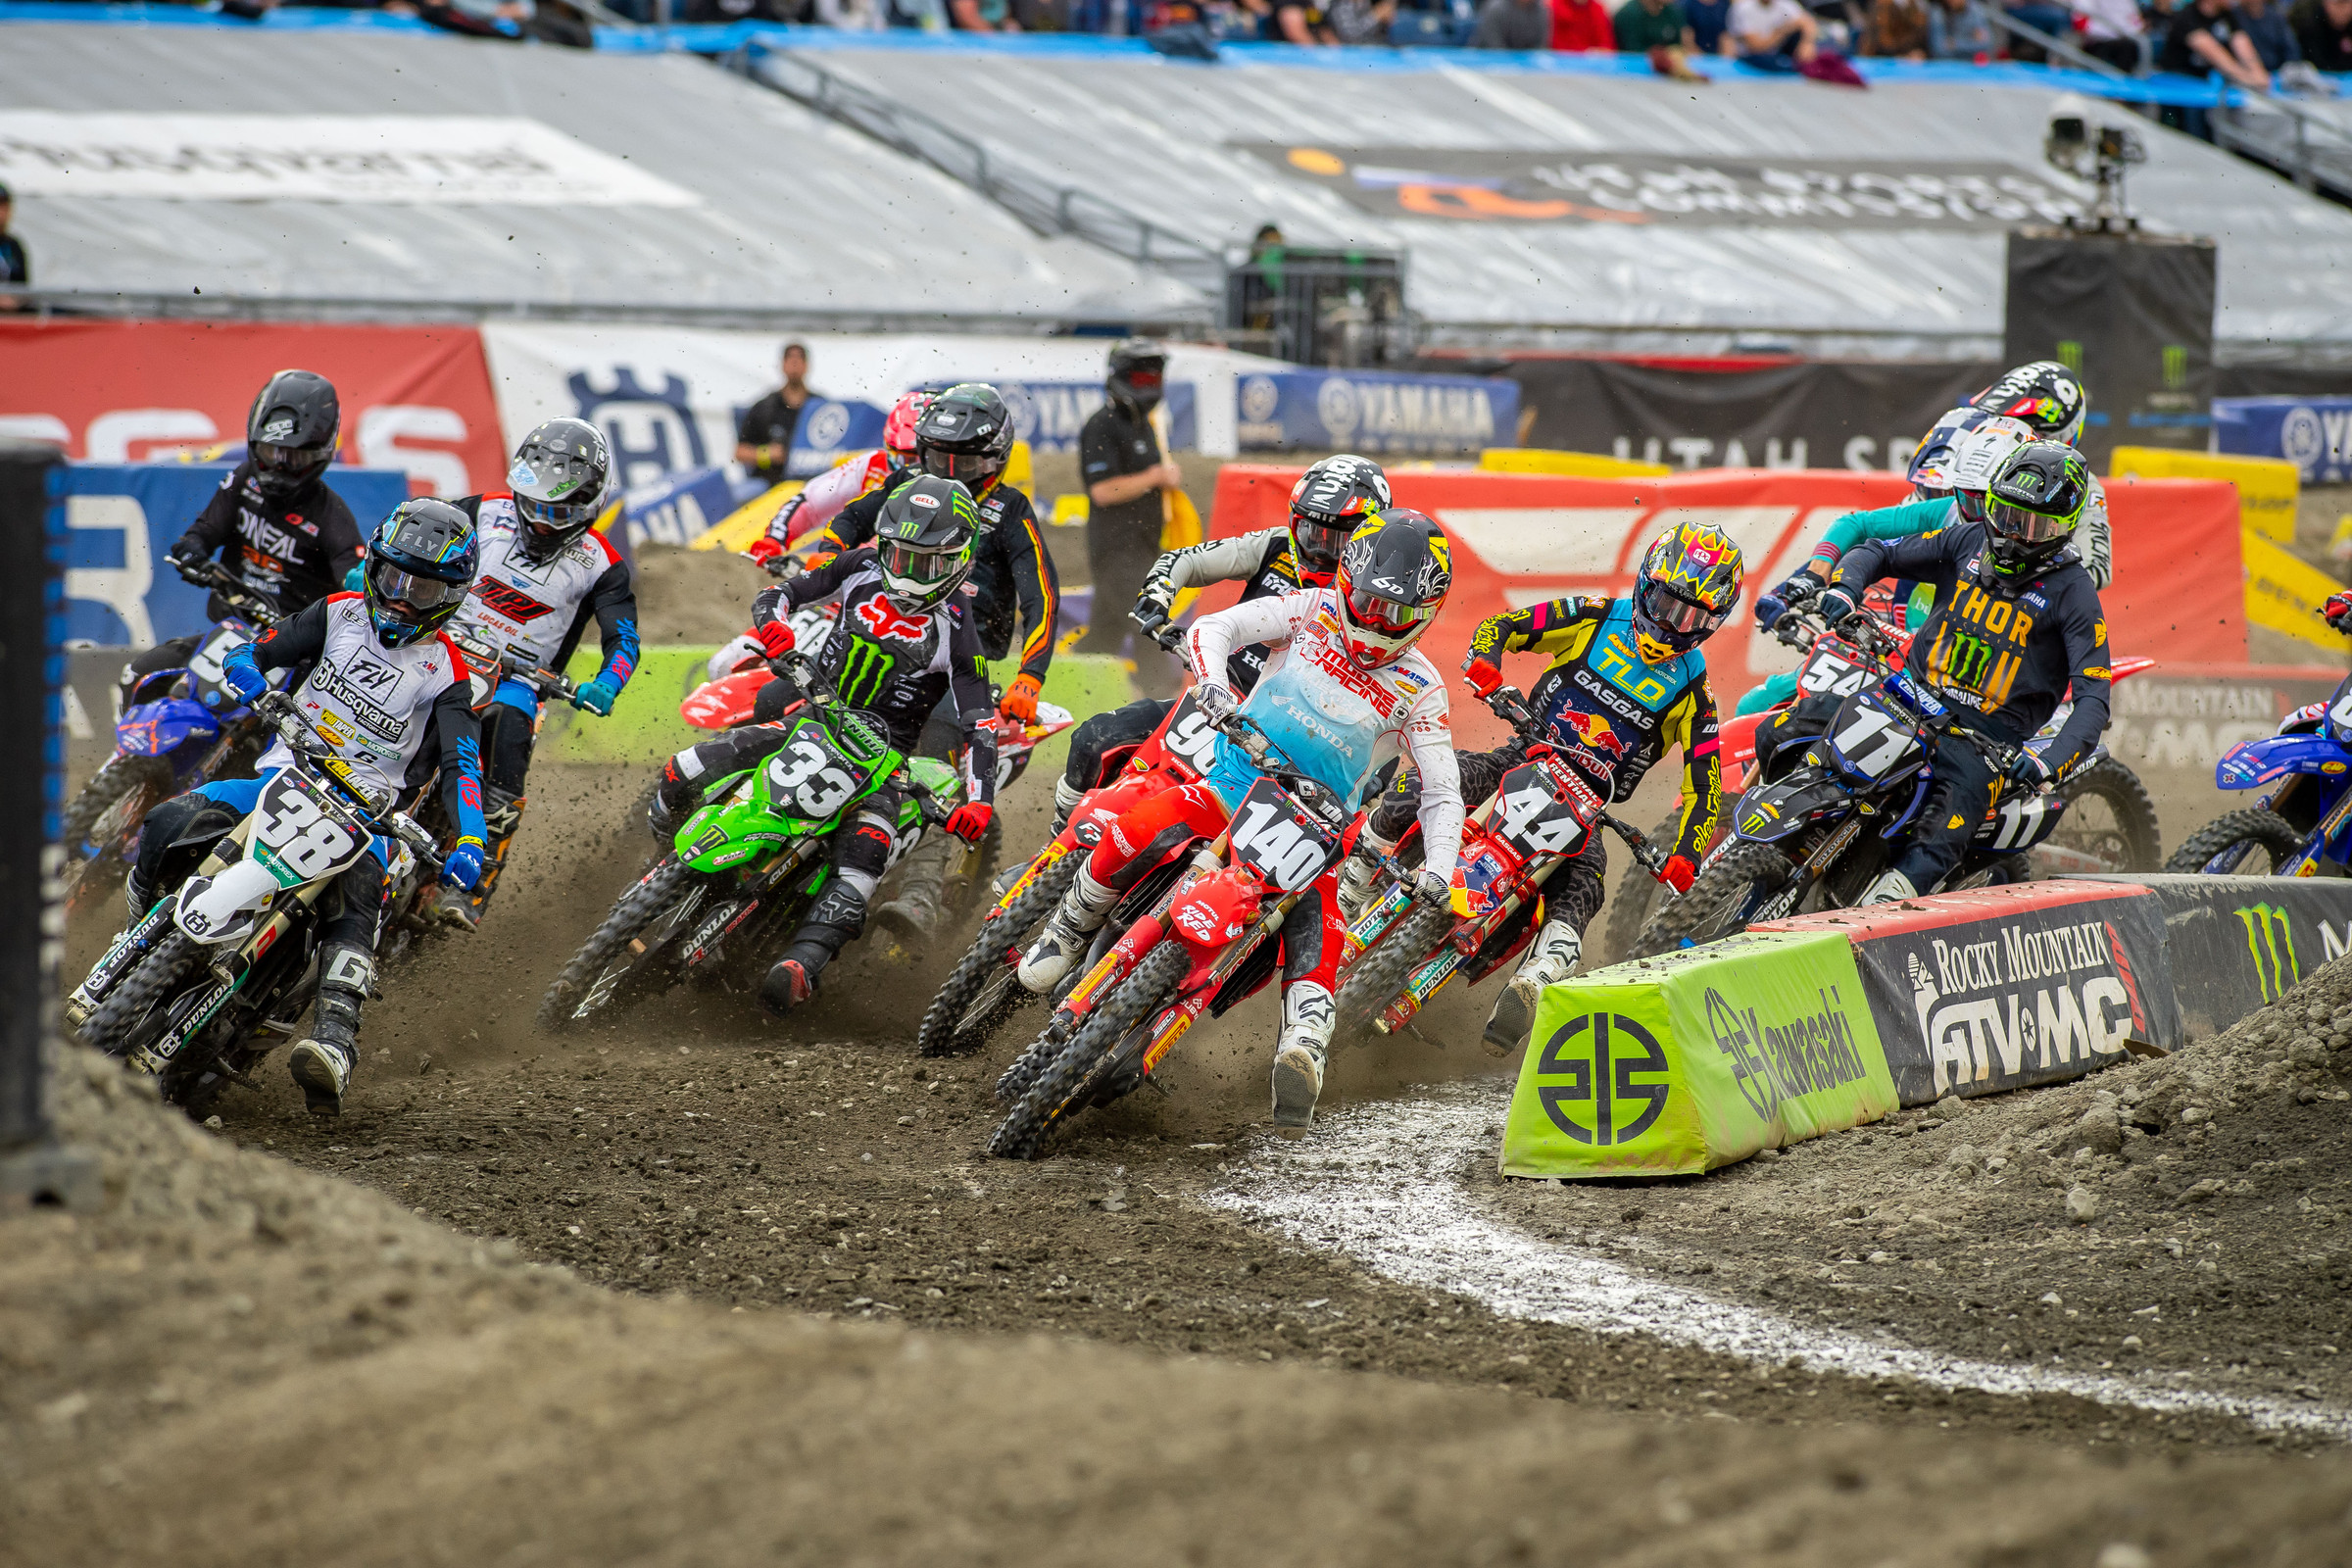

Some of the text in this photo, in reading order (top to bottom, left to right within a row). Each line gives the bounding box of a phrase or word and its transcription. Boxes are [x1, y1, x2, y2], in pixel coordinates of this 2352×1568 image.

[1363, 385, 1494, 437] YAMAHA
[915, 496, 935, 507] BELL
[2000, 484, 2036, 501] MONSTER
[400, 532, 438, 553] FLY
[1372, 576, 1404, 595] 6D
[477, 612, 519, 637] LUCAS OIL
[1948, 579, 2034, 648] THOR
[347, 660, 396, 690] FLY
[1313, 657, 1393, 720] RACING
[1323, 648, 1399, 707] MOOSE
[1596, 646, 1667, 705] TLD
[1653, 668, 1678, 686] MOTOREX
[1800, 652, 1879, 698] 54
[328, 676, 404, 734] Husqvarna
[1573, 669, 1655, 730] GASGAS
[322, 710, 355, 739] PROTAPER
[1889, 701, 1917, 729] MONSTER
[1285, 703, 1355, 760] HONDA
[1833, 704, 1923, 778] 11
[367, 741, 401, 760] MOTOREX
[826, 742, 855, 771] MONSTER
[769, 740, 857, 818] 33
[1170, 756, 1198, 780] HONDA
[1291, 805, 1323, 835] MONSTER
[1493, 786, 1583, 855] 44
[1754, 808, 1773, 824] YAMAHA
[1992, 798, 2045, 850] 11
[256, 788, 355, 880] 38
[856, 825, 892, 850] FOX
[1231, 800, 1327, 894] 140
[1494, 833, 1523, 862] GASGAS
[1814, 819, 1860, 868] enzoracing
[266, 853, 296, 881] MOTOREX
[1181, 904, 1217, 929] RIDE
[1195, 899, 1220, 922] MOTUL
[1763, 892, 1785, 915] CYCRA
[1176, 912, 1212, 942] RED
[1932, 939, 2003, 996] ROCKY
[2000, 921, 2112, 984] MOUNTAIN
[1418, 954, 1458, 999] DUNLOP
[197, 986, 236, 1029] MOTOREX
[1739, 984, 1867, 1125] Kawasaki
